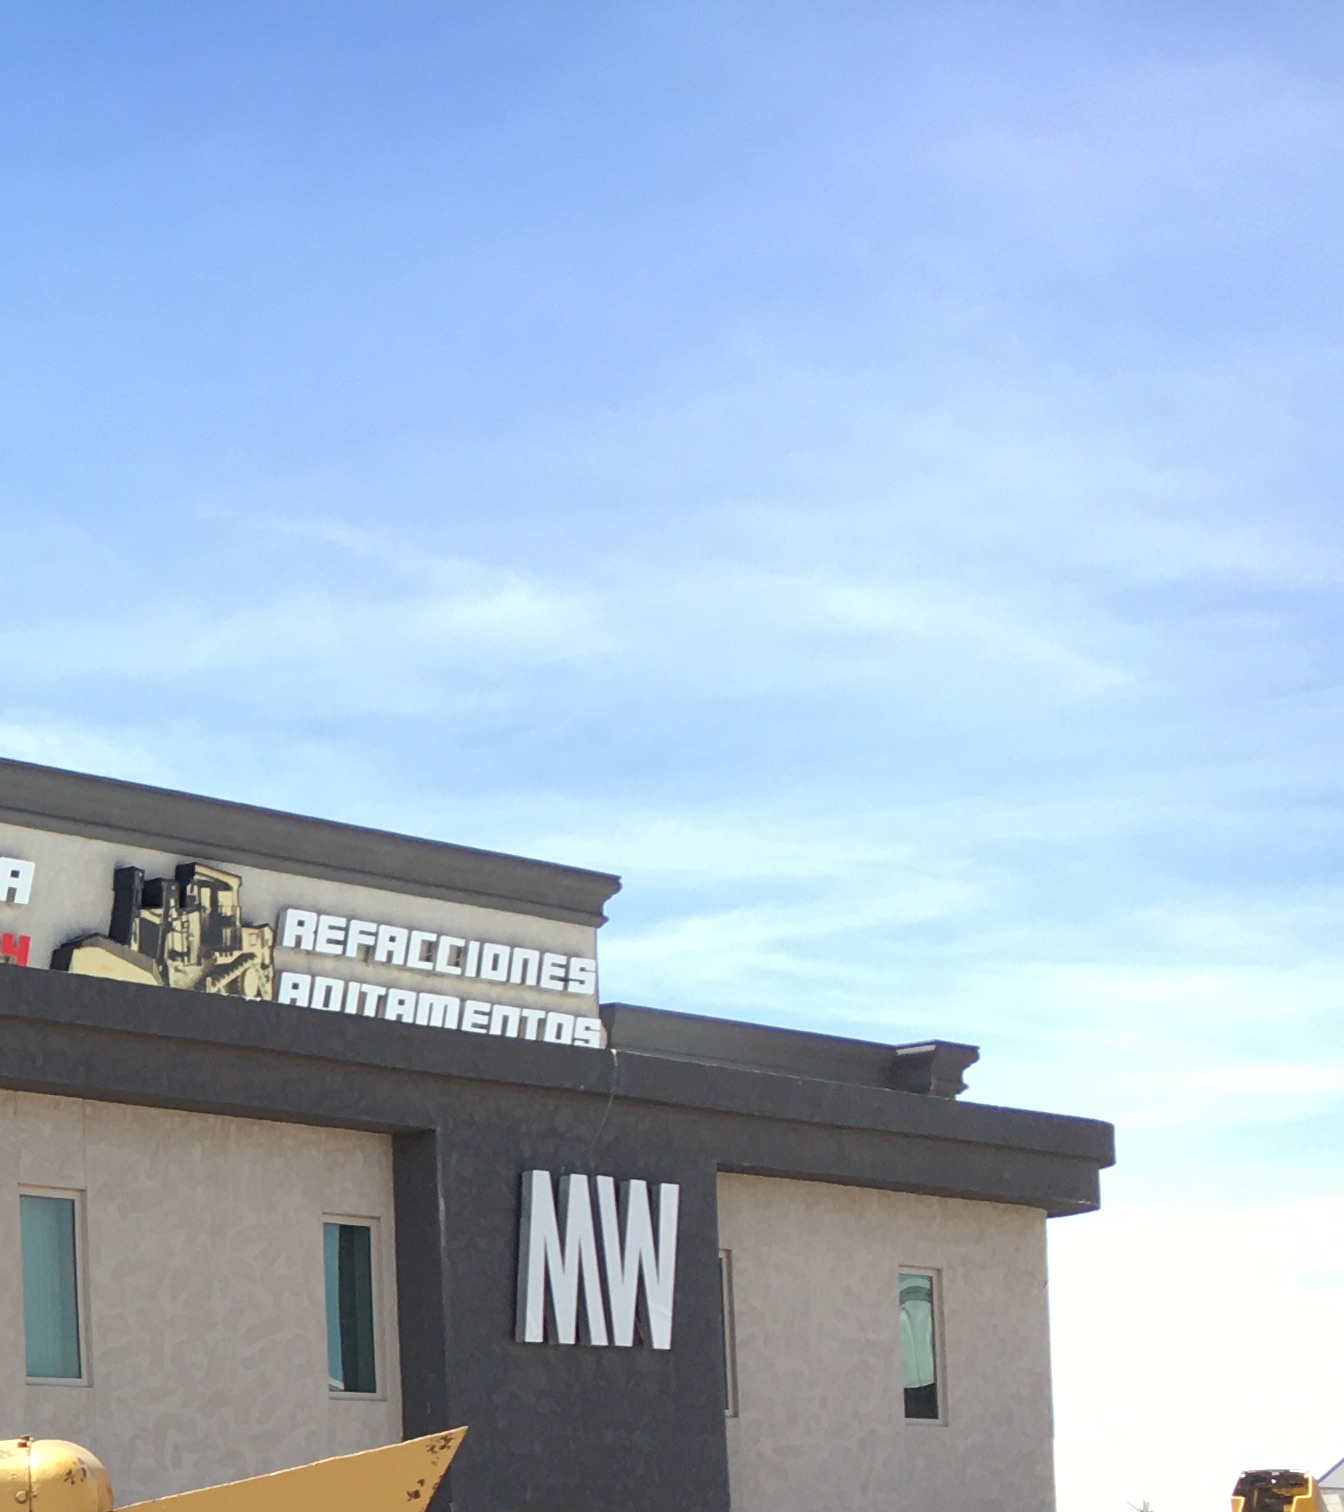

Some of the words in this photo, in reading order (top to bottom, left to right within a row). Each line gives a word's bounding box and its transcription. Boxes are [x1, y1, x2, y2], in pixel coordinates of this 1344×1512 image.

[281, 908, 596, 995] REFACCIONES
[278, 972, 601, 1048] ADITAMENTOS
[524, 1169, 680, 1350] MW
